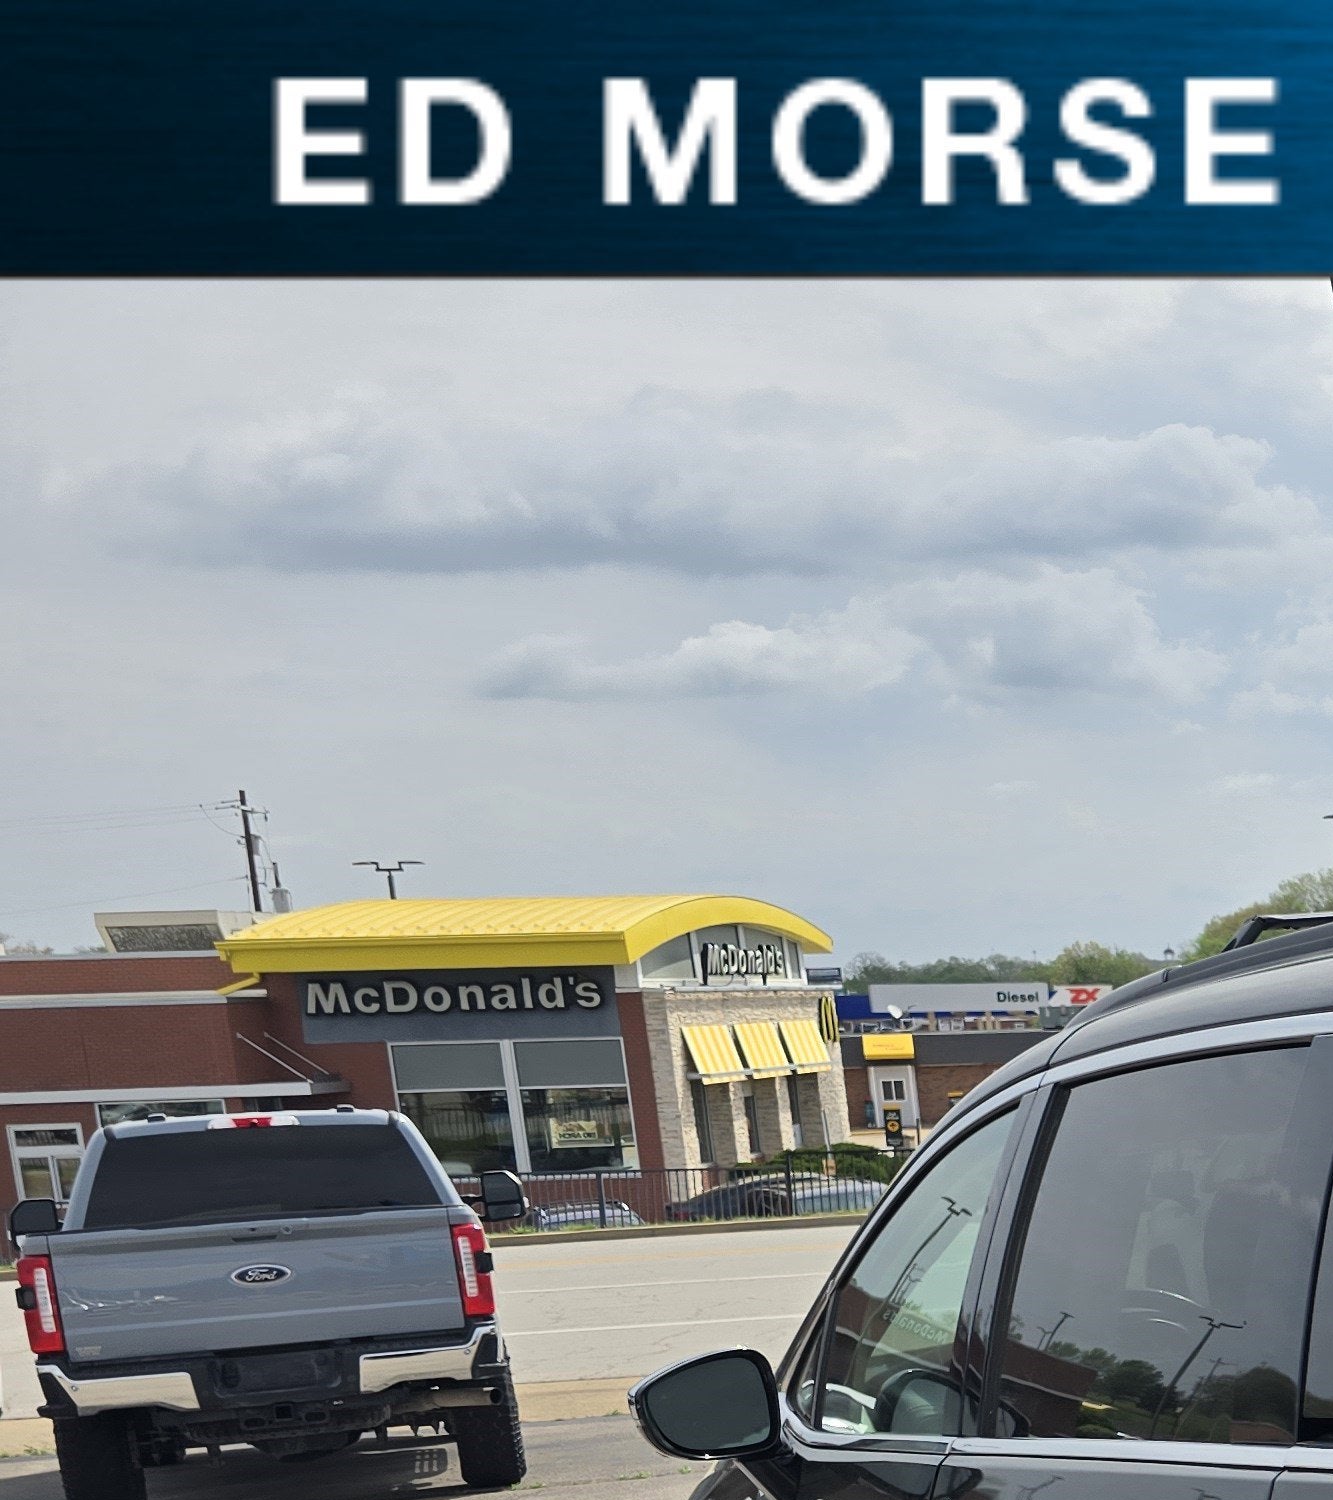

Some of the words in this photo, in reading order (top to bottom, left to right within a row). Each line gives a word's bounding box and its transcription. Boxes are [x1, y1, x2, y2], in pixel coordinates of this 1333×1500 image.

[704, 943, 784, 976] McDonald's
[306, 976, 602, 1014] McDonald's
[996, 991, 1040, 1003] Diesel
[245, 1268, 279, 1283] Ford
